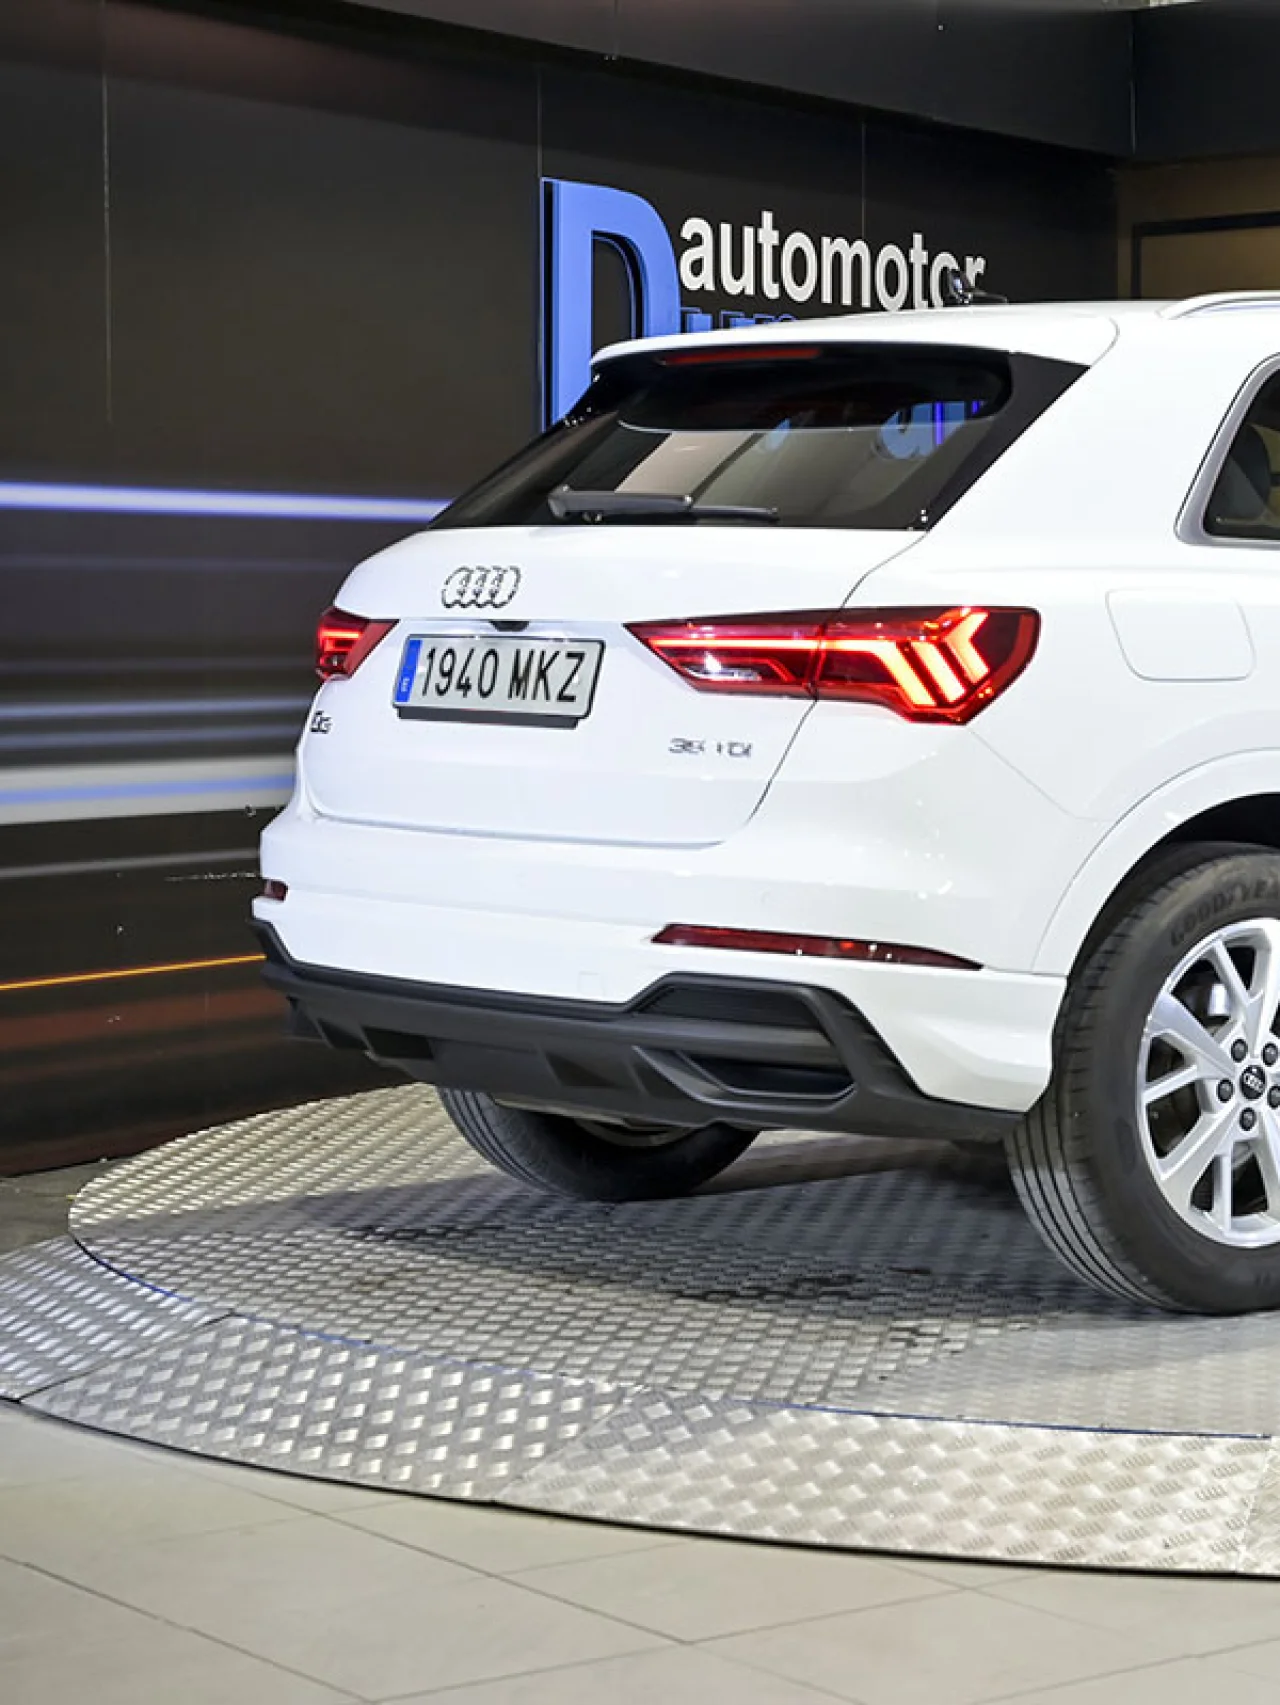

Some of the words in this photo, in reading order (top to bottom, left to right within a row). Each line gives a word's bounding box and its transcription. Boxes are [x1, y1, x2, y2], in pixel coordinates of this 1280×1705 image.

[679, 211, 986, 312] automotor
[422, 647, 500, 699] 1940
[507, 648, 586, 703] MKZ
